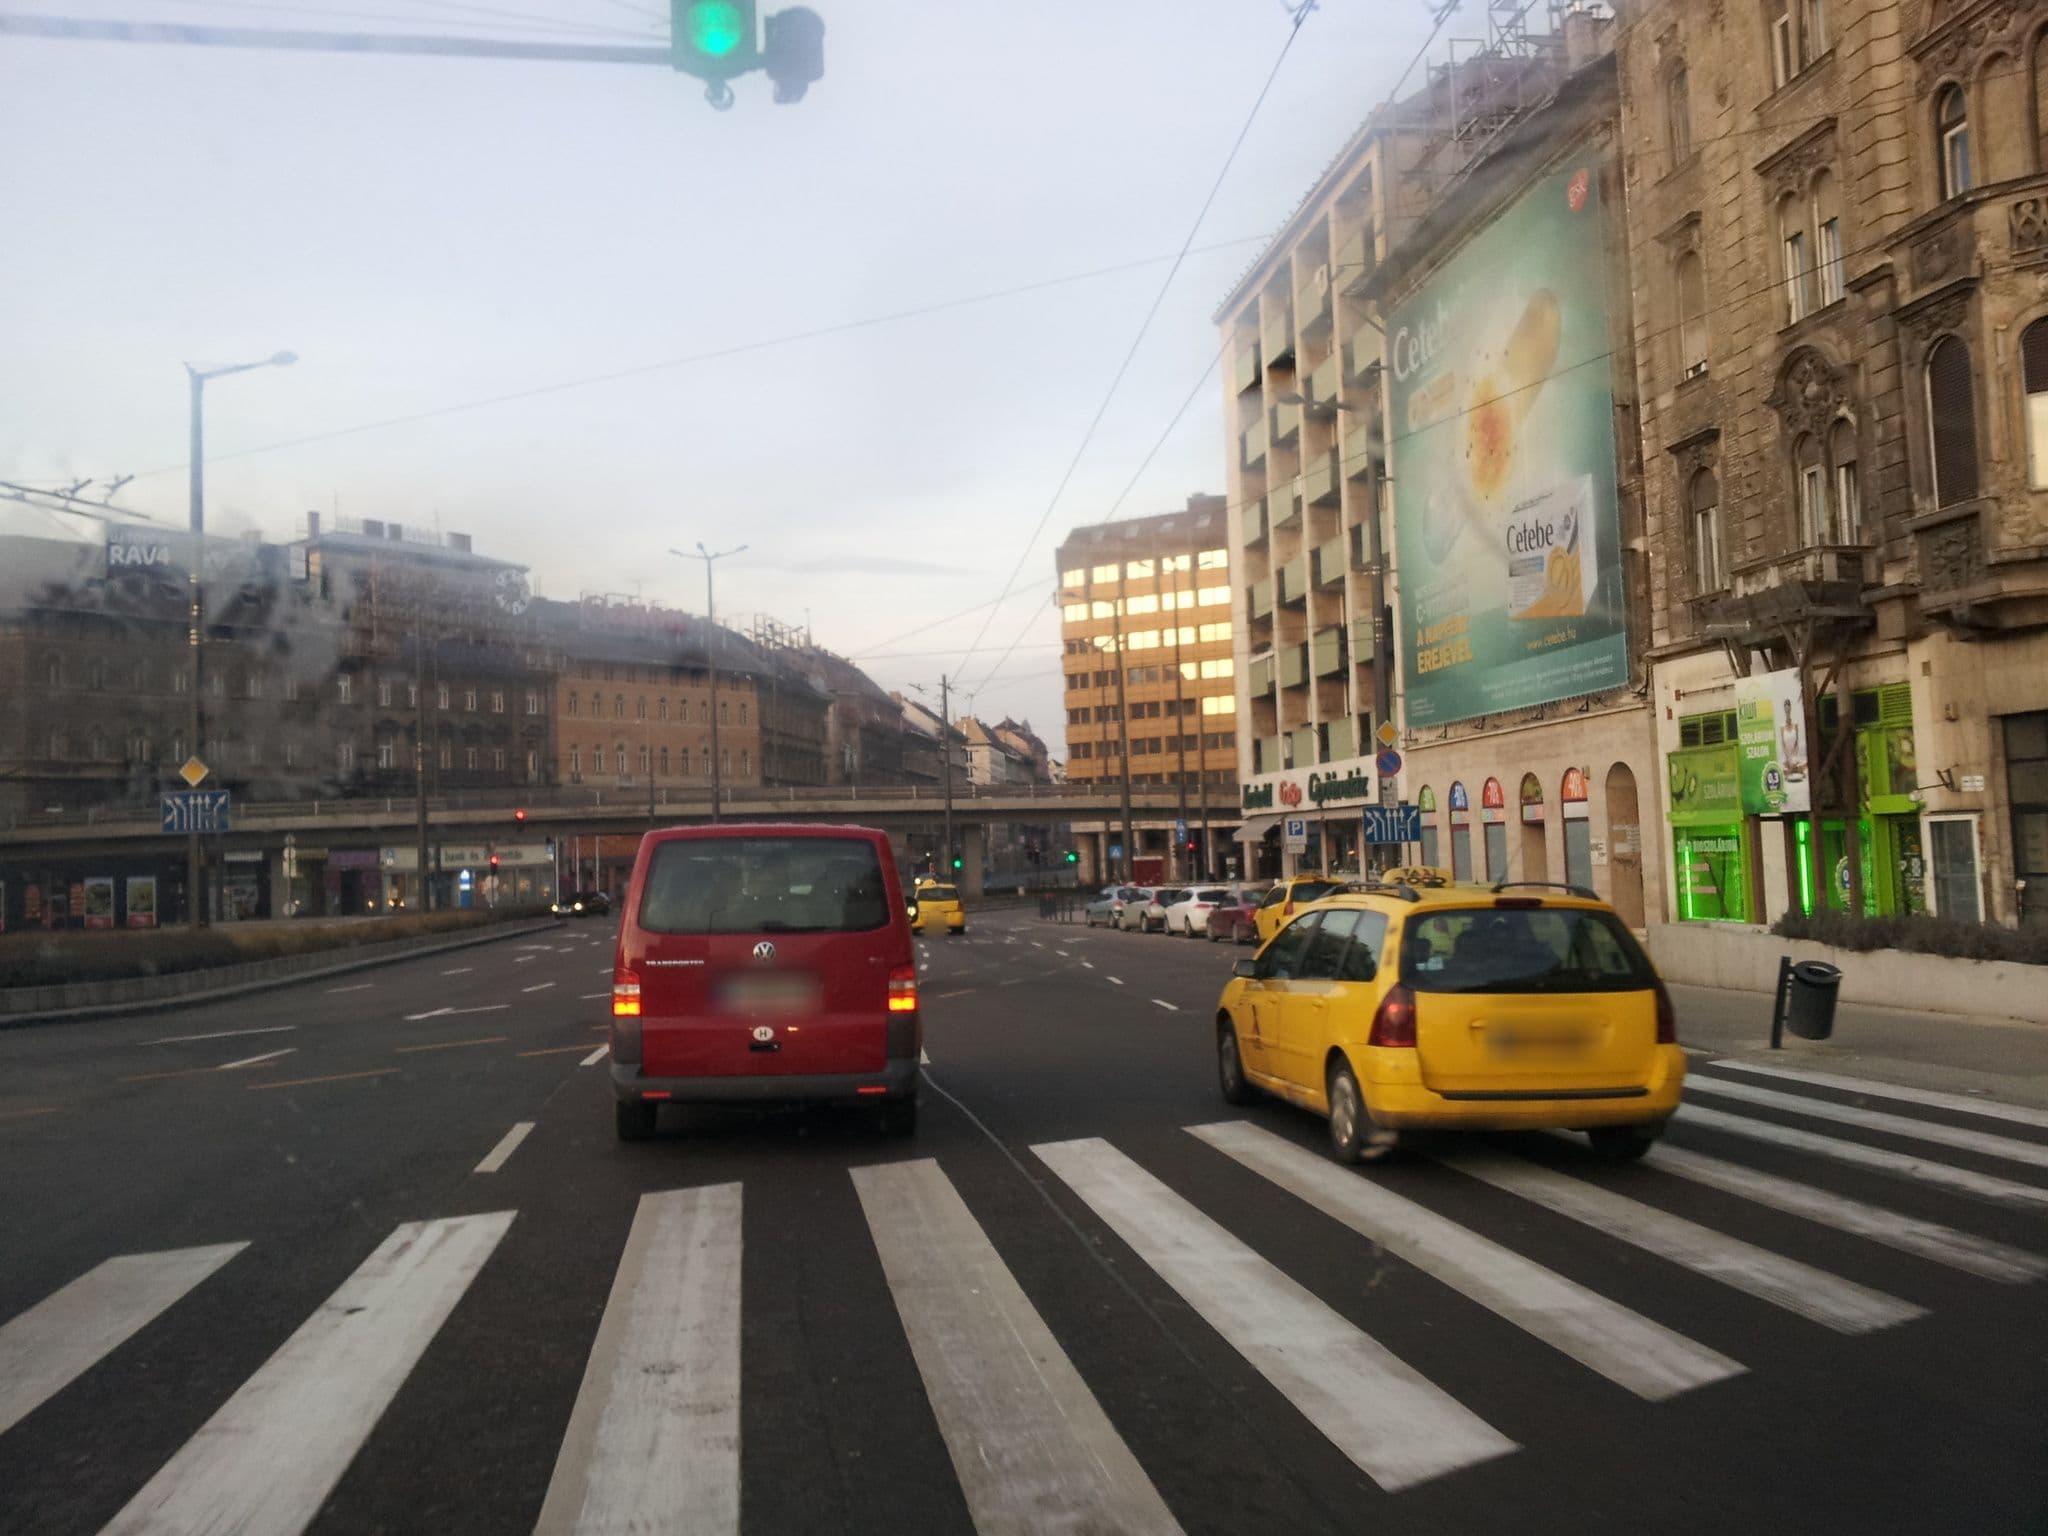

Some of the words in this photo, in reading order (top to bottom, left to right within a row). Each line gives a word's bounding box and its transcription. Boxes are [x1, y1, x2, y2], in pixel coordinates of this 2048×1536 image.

[1506, 519, 1554, 554] Cetebe
[109, 544, 170, 566] RAV4
[759, 1029, 768, 1038] H
